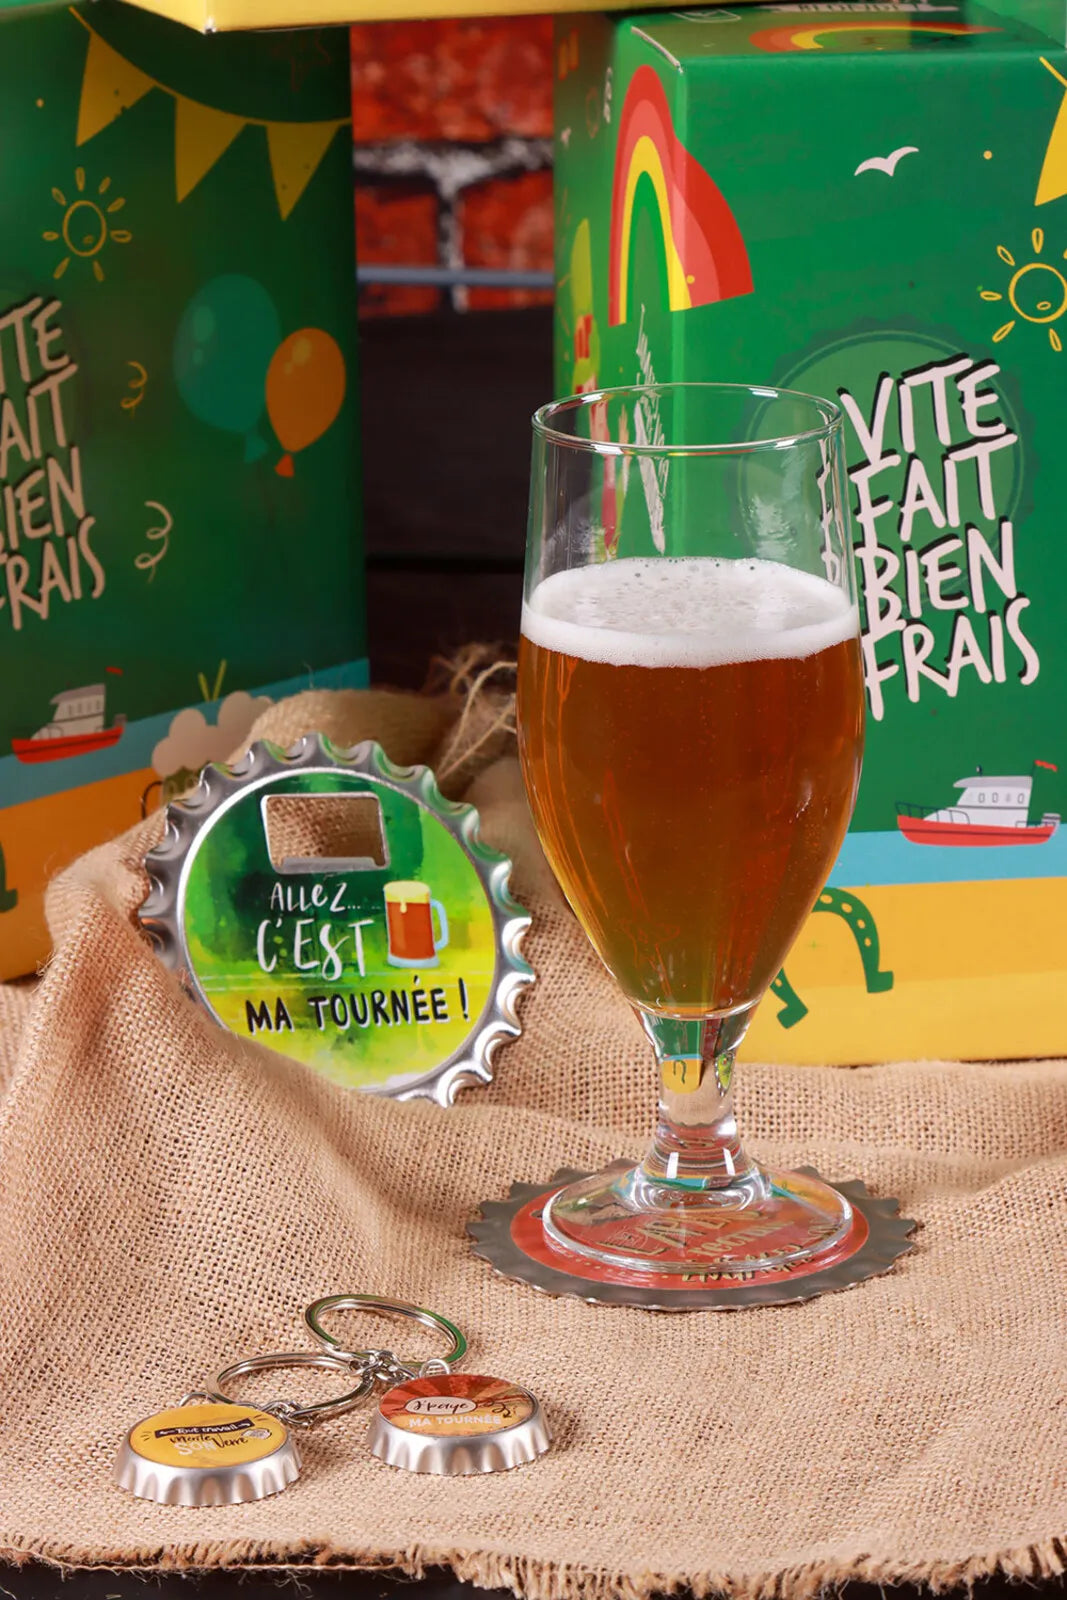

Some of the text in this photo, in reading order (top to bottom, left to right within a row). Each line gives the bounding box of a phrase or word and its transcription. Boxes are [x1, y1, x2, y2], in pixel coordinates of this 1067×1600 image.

[0, 363, 77, 478] AIT
[838, 353, 1006, 465] VITE
[0, 446, 86, 551] IEN
[848, 432, 1017, 552] FAIT
[0, 516, 105, 630] RAIS
[853, 515, 1016, 637] BIEN
[861, 593, 1040, 721] FRAIS
[256, 914, 374, 981] C'EST
[245, 997, 295, 1036] MA
[307, 974, 451, 1031] TOURNÉE
[409, 1418, 432, 1428] MA
